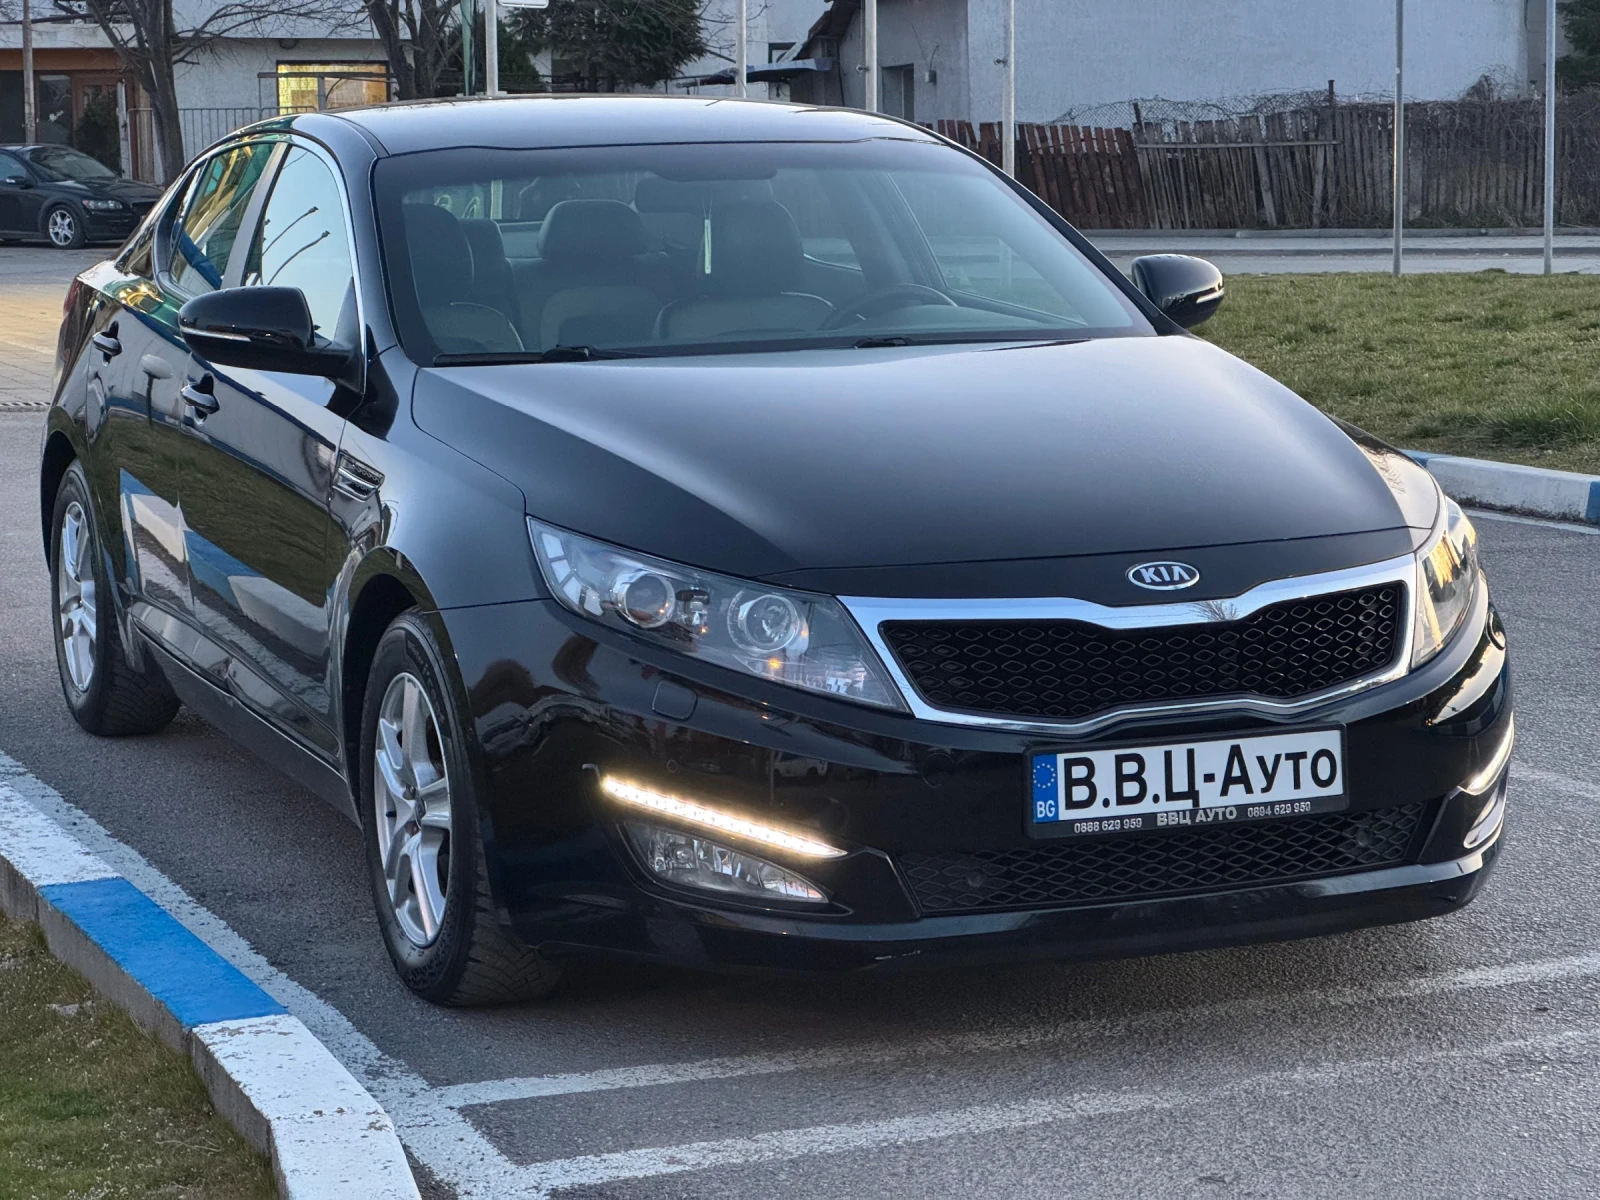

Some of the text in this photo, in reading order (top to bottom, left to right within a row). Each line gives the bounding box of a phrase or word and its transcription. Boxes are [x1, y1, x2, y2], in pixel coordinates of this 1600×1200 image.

[1139, 565, 1191, 583] KIA
[1063, 744, 1338, 811] В.В.Ц-Ауто
[1036, 799, 1056, 818] BG
[1156, 806, 1237, 827] ВВЦ АУТО
[1274, 804, 1293, 815] 629
[1074, 818, 1143, 834] 0888 629 959
